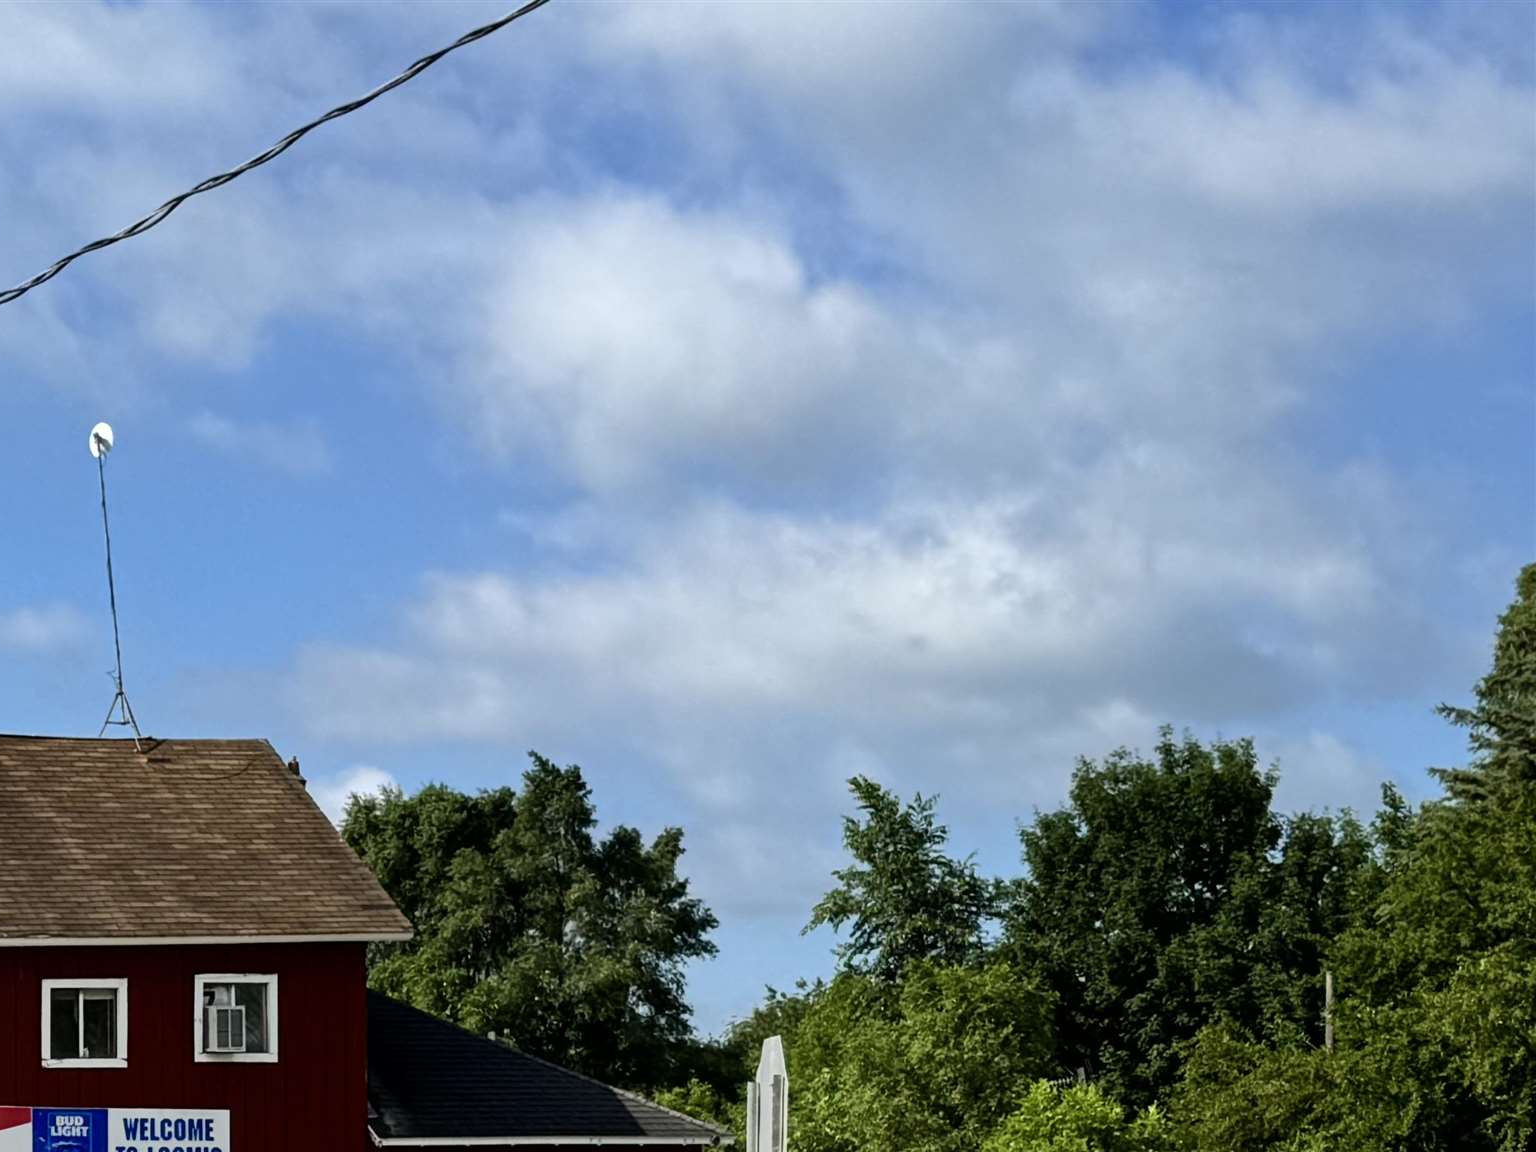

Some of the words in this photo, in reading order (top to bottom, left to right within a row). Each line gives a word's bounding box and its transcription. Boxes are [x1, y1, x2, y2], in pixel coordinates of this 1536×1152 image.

[55, 1115, 84, 1126] BUD
[50, 1126, 89, 1137] LIGHT
[122, 1117, 215, 1141] WELCOME
